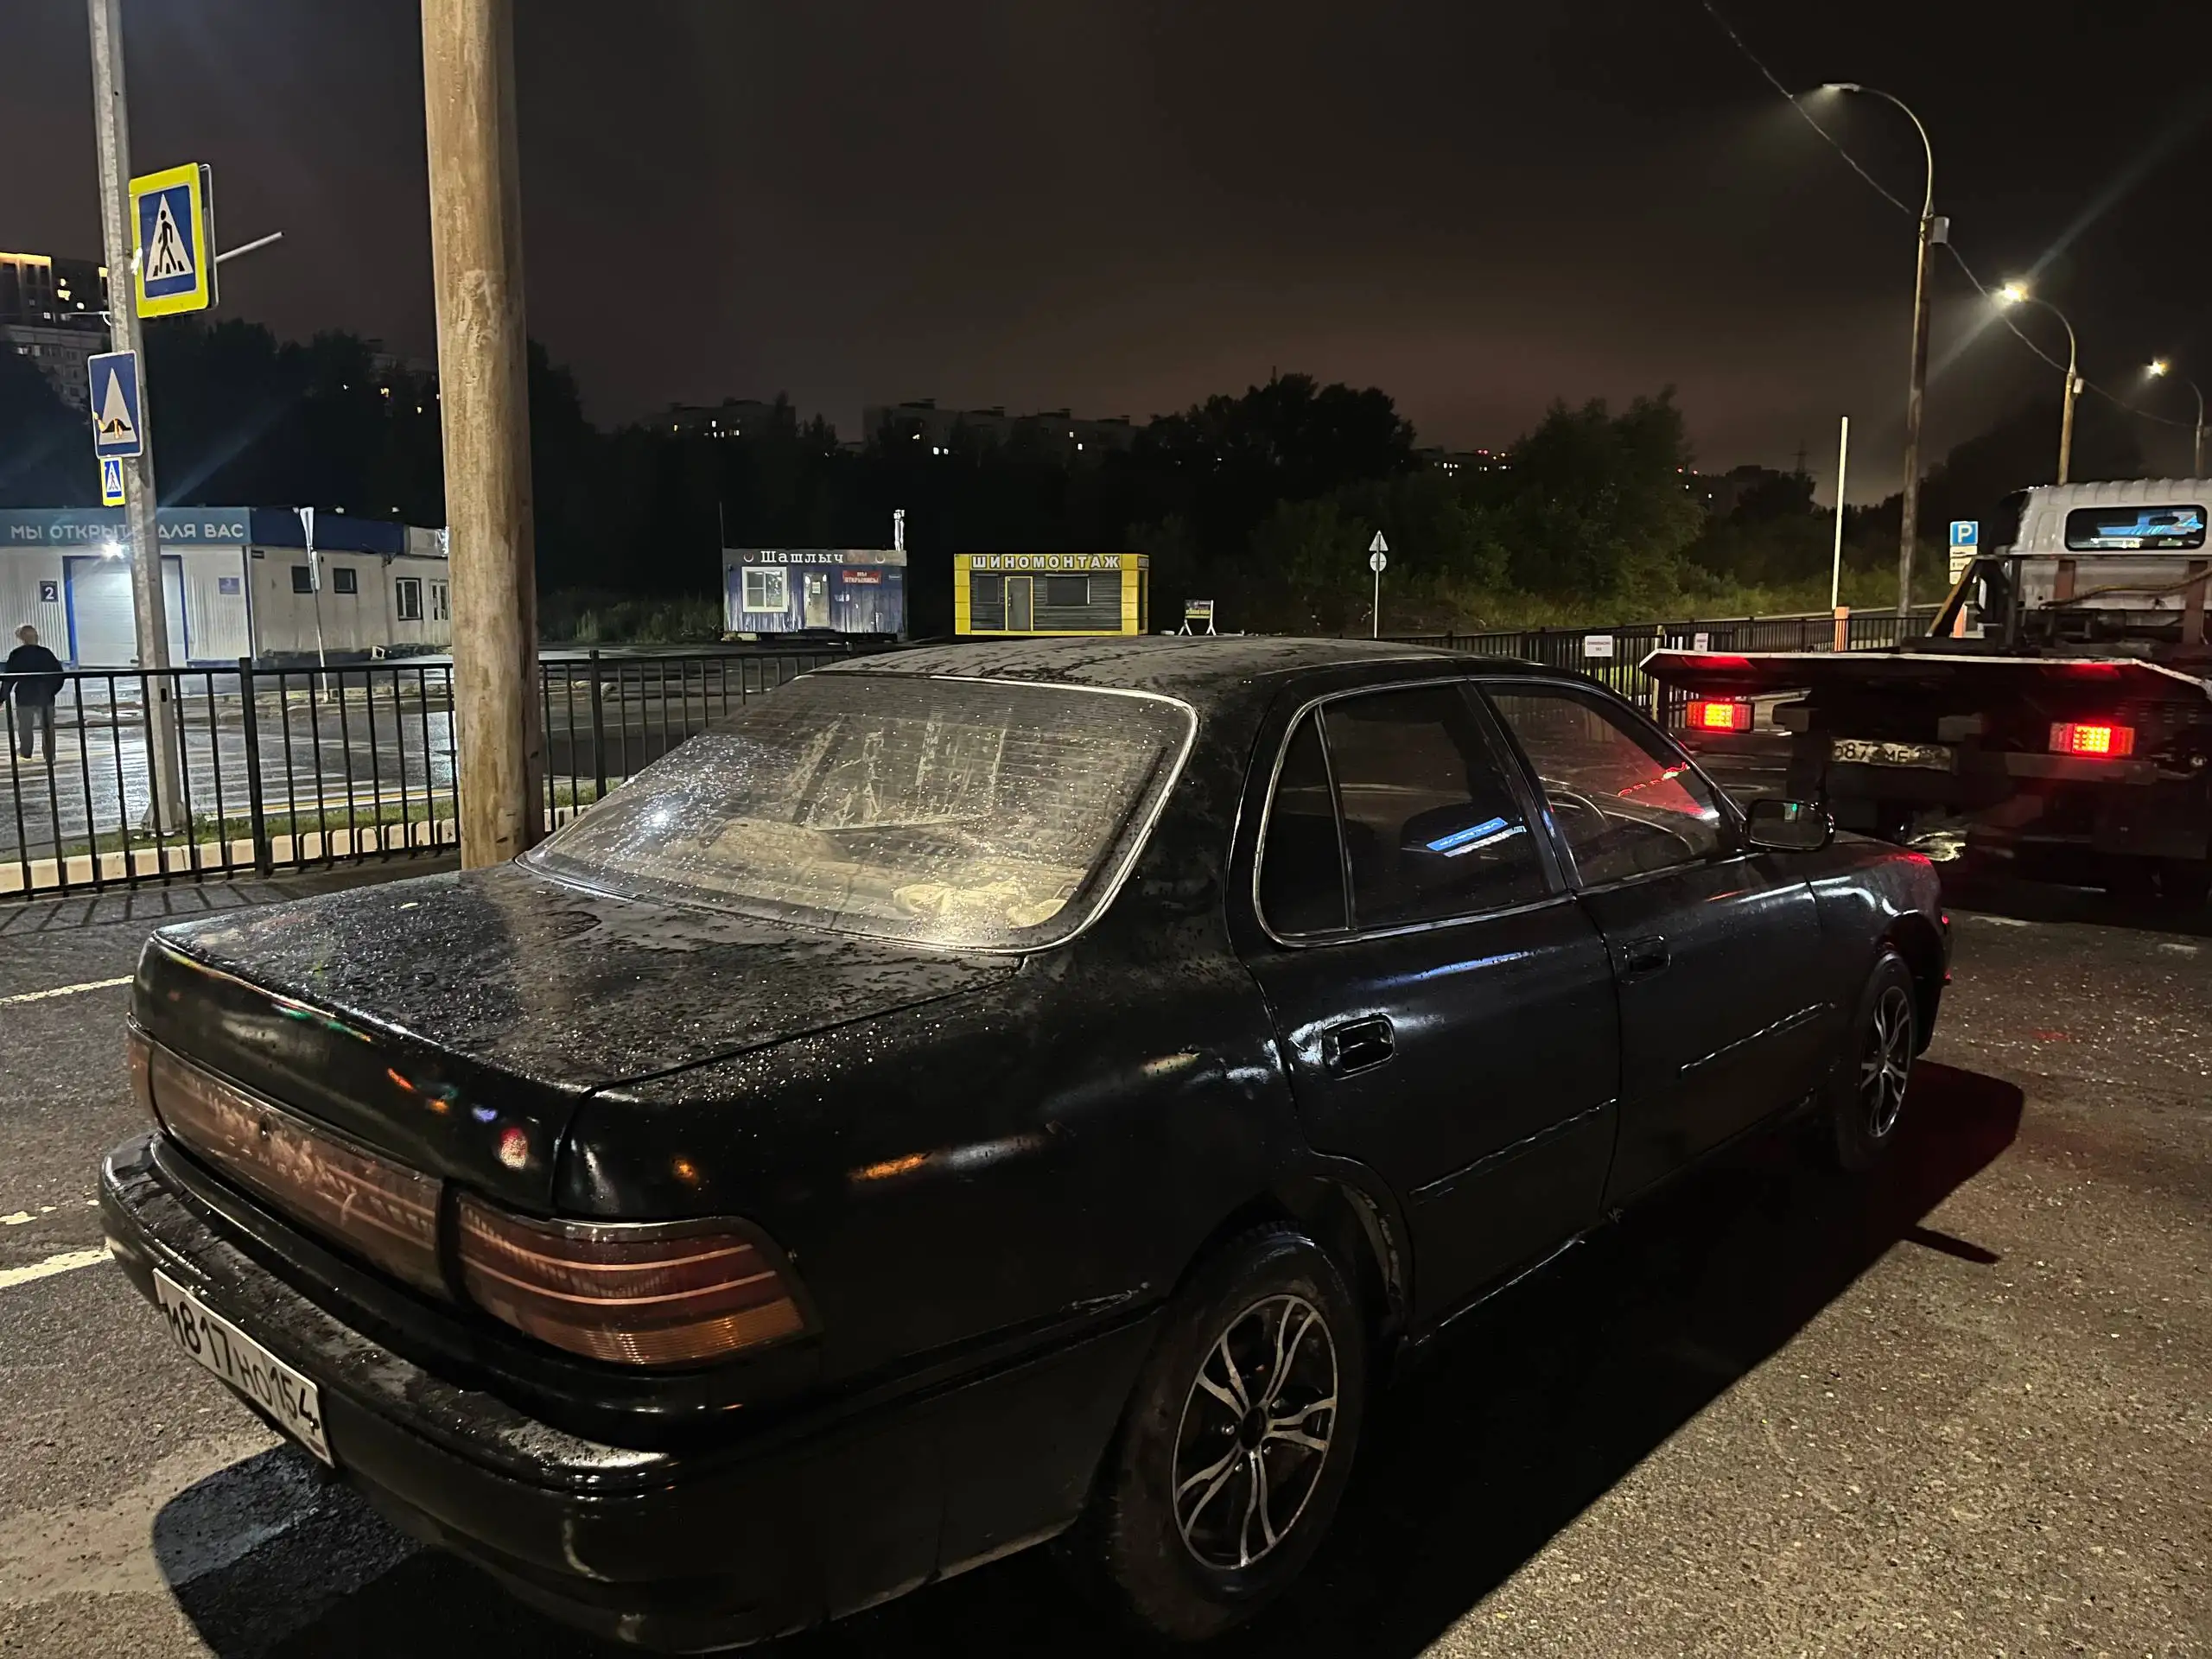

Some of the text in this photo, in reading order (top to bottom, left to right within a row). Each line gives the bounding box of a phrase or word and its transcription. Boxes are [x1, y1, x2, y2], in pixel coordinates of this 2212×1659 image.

[10, 524, 244, 540] МЫ ОТКРЫТ ДЛЯ ВАС
[1958, 524, 1973, 543] P
[971, 555, 1120, 569] ШИНОМОНТАЖ
[45, 587, 54, 600] 2
